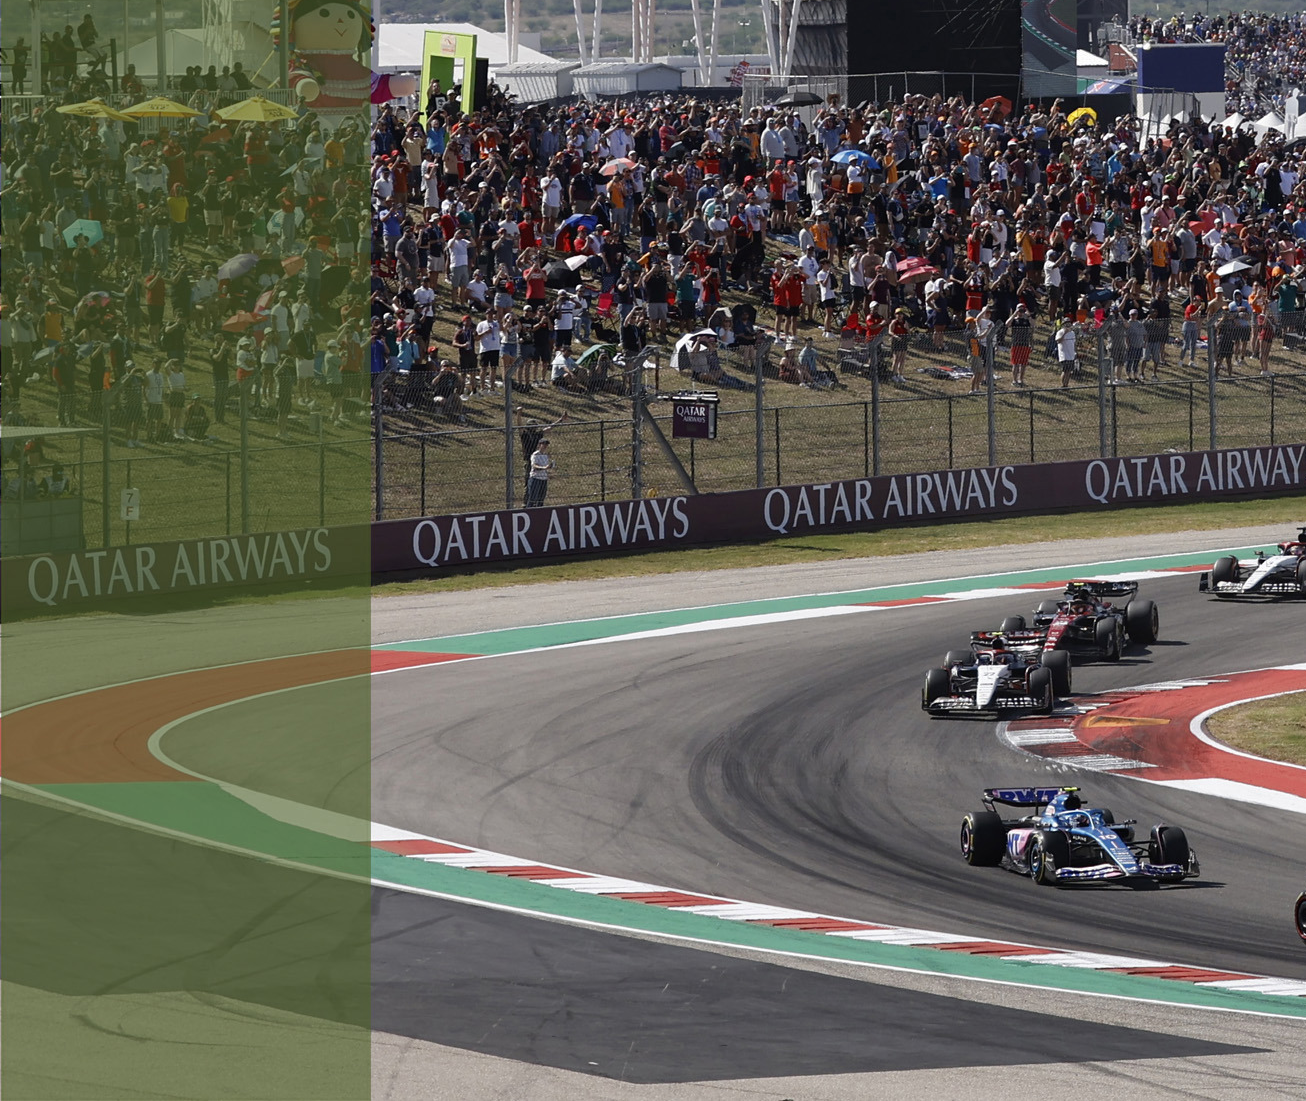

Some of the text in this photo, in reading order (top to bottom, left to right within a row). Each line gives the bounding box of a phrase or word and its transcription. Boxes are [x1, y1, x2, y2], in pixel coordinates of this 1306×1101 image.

[676, 405, 706, 417] QATAR
[126, 492, 134, 503] 7
[763, 466, 1018, 535] QATAR AIRWAYS
[1085, 455, 1189, 504] QATAR
[126, 506, 134, 517] F
[412, 496, 690, 567] QATAR AIRWAYS
[28, 528, 332, 606] QATAR AIRWAYS
